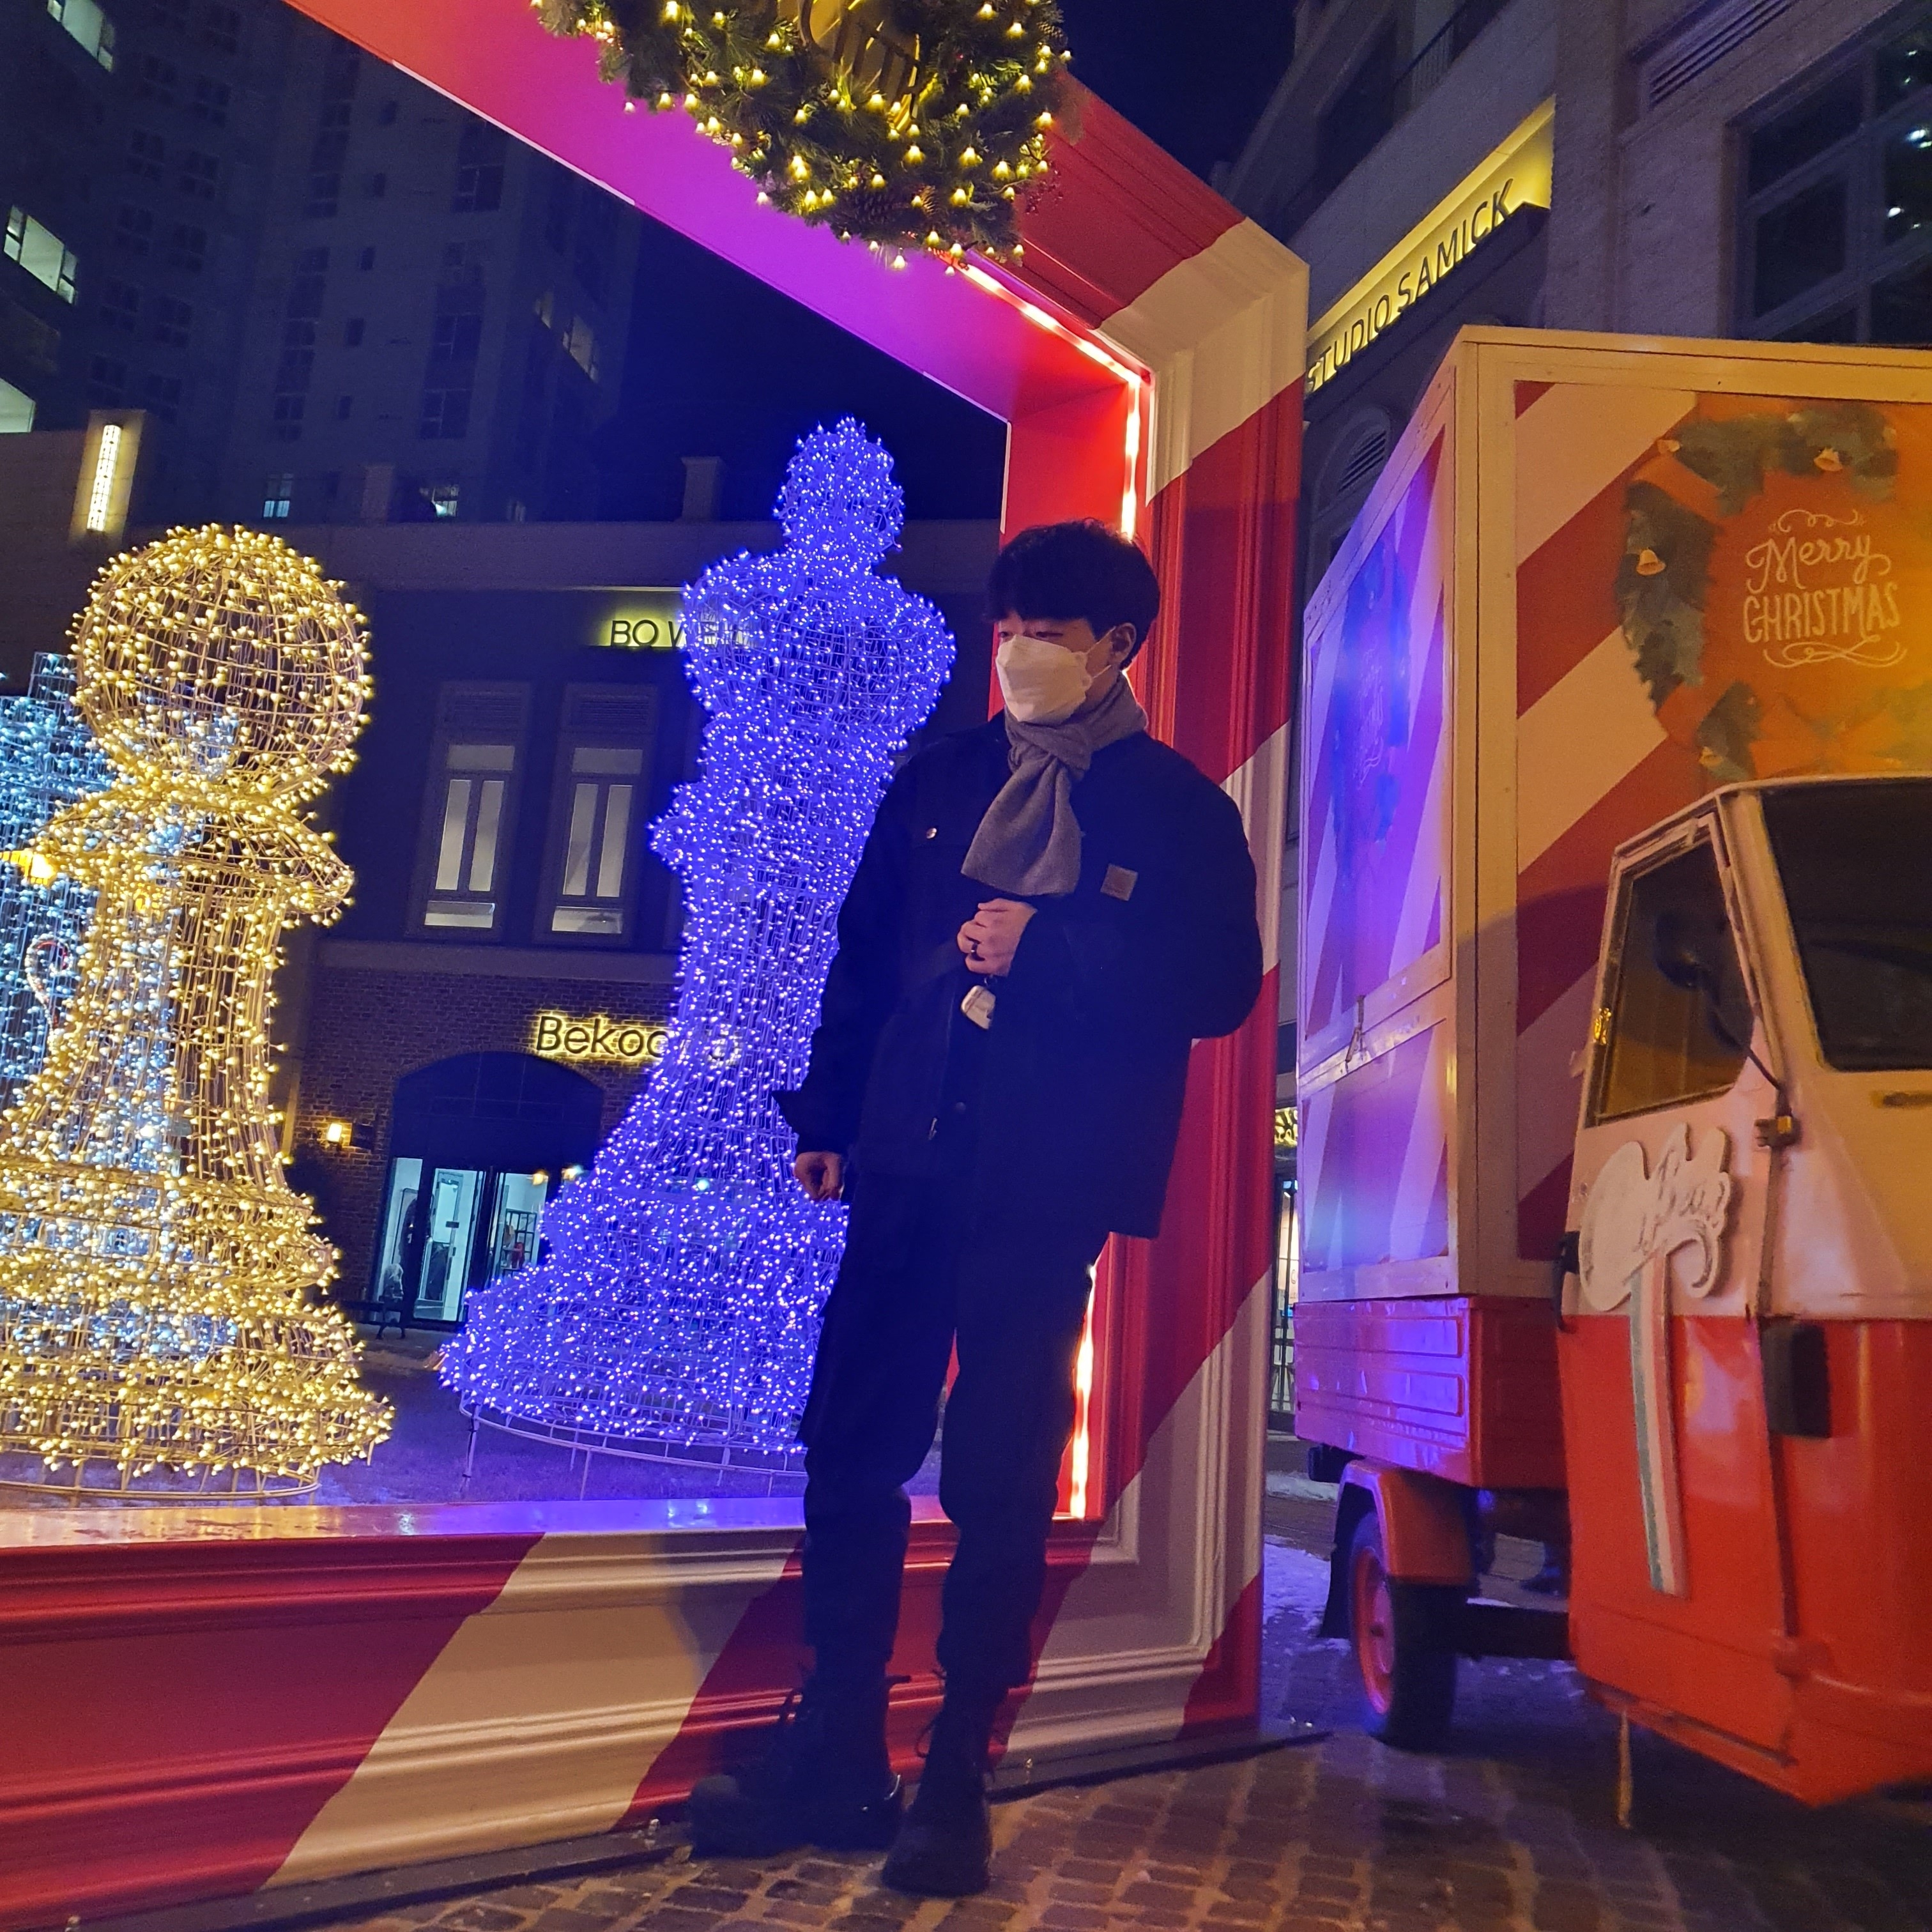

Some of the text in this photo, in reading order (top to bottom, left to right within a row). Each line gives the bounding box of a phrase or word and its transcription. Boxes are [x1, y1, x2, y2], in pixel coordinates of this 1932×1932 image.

[1307, 178, 1514, 393] STUDIO SAMICK
[1745, 535, 1891, 594] Merry
[1743, 581, 1901, 644] CHRISTMAS
